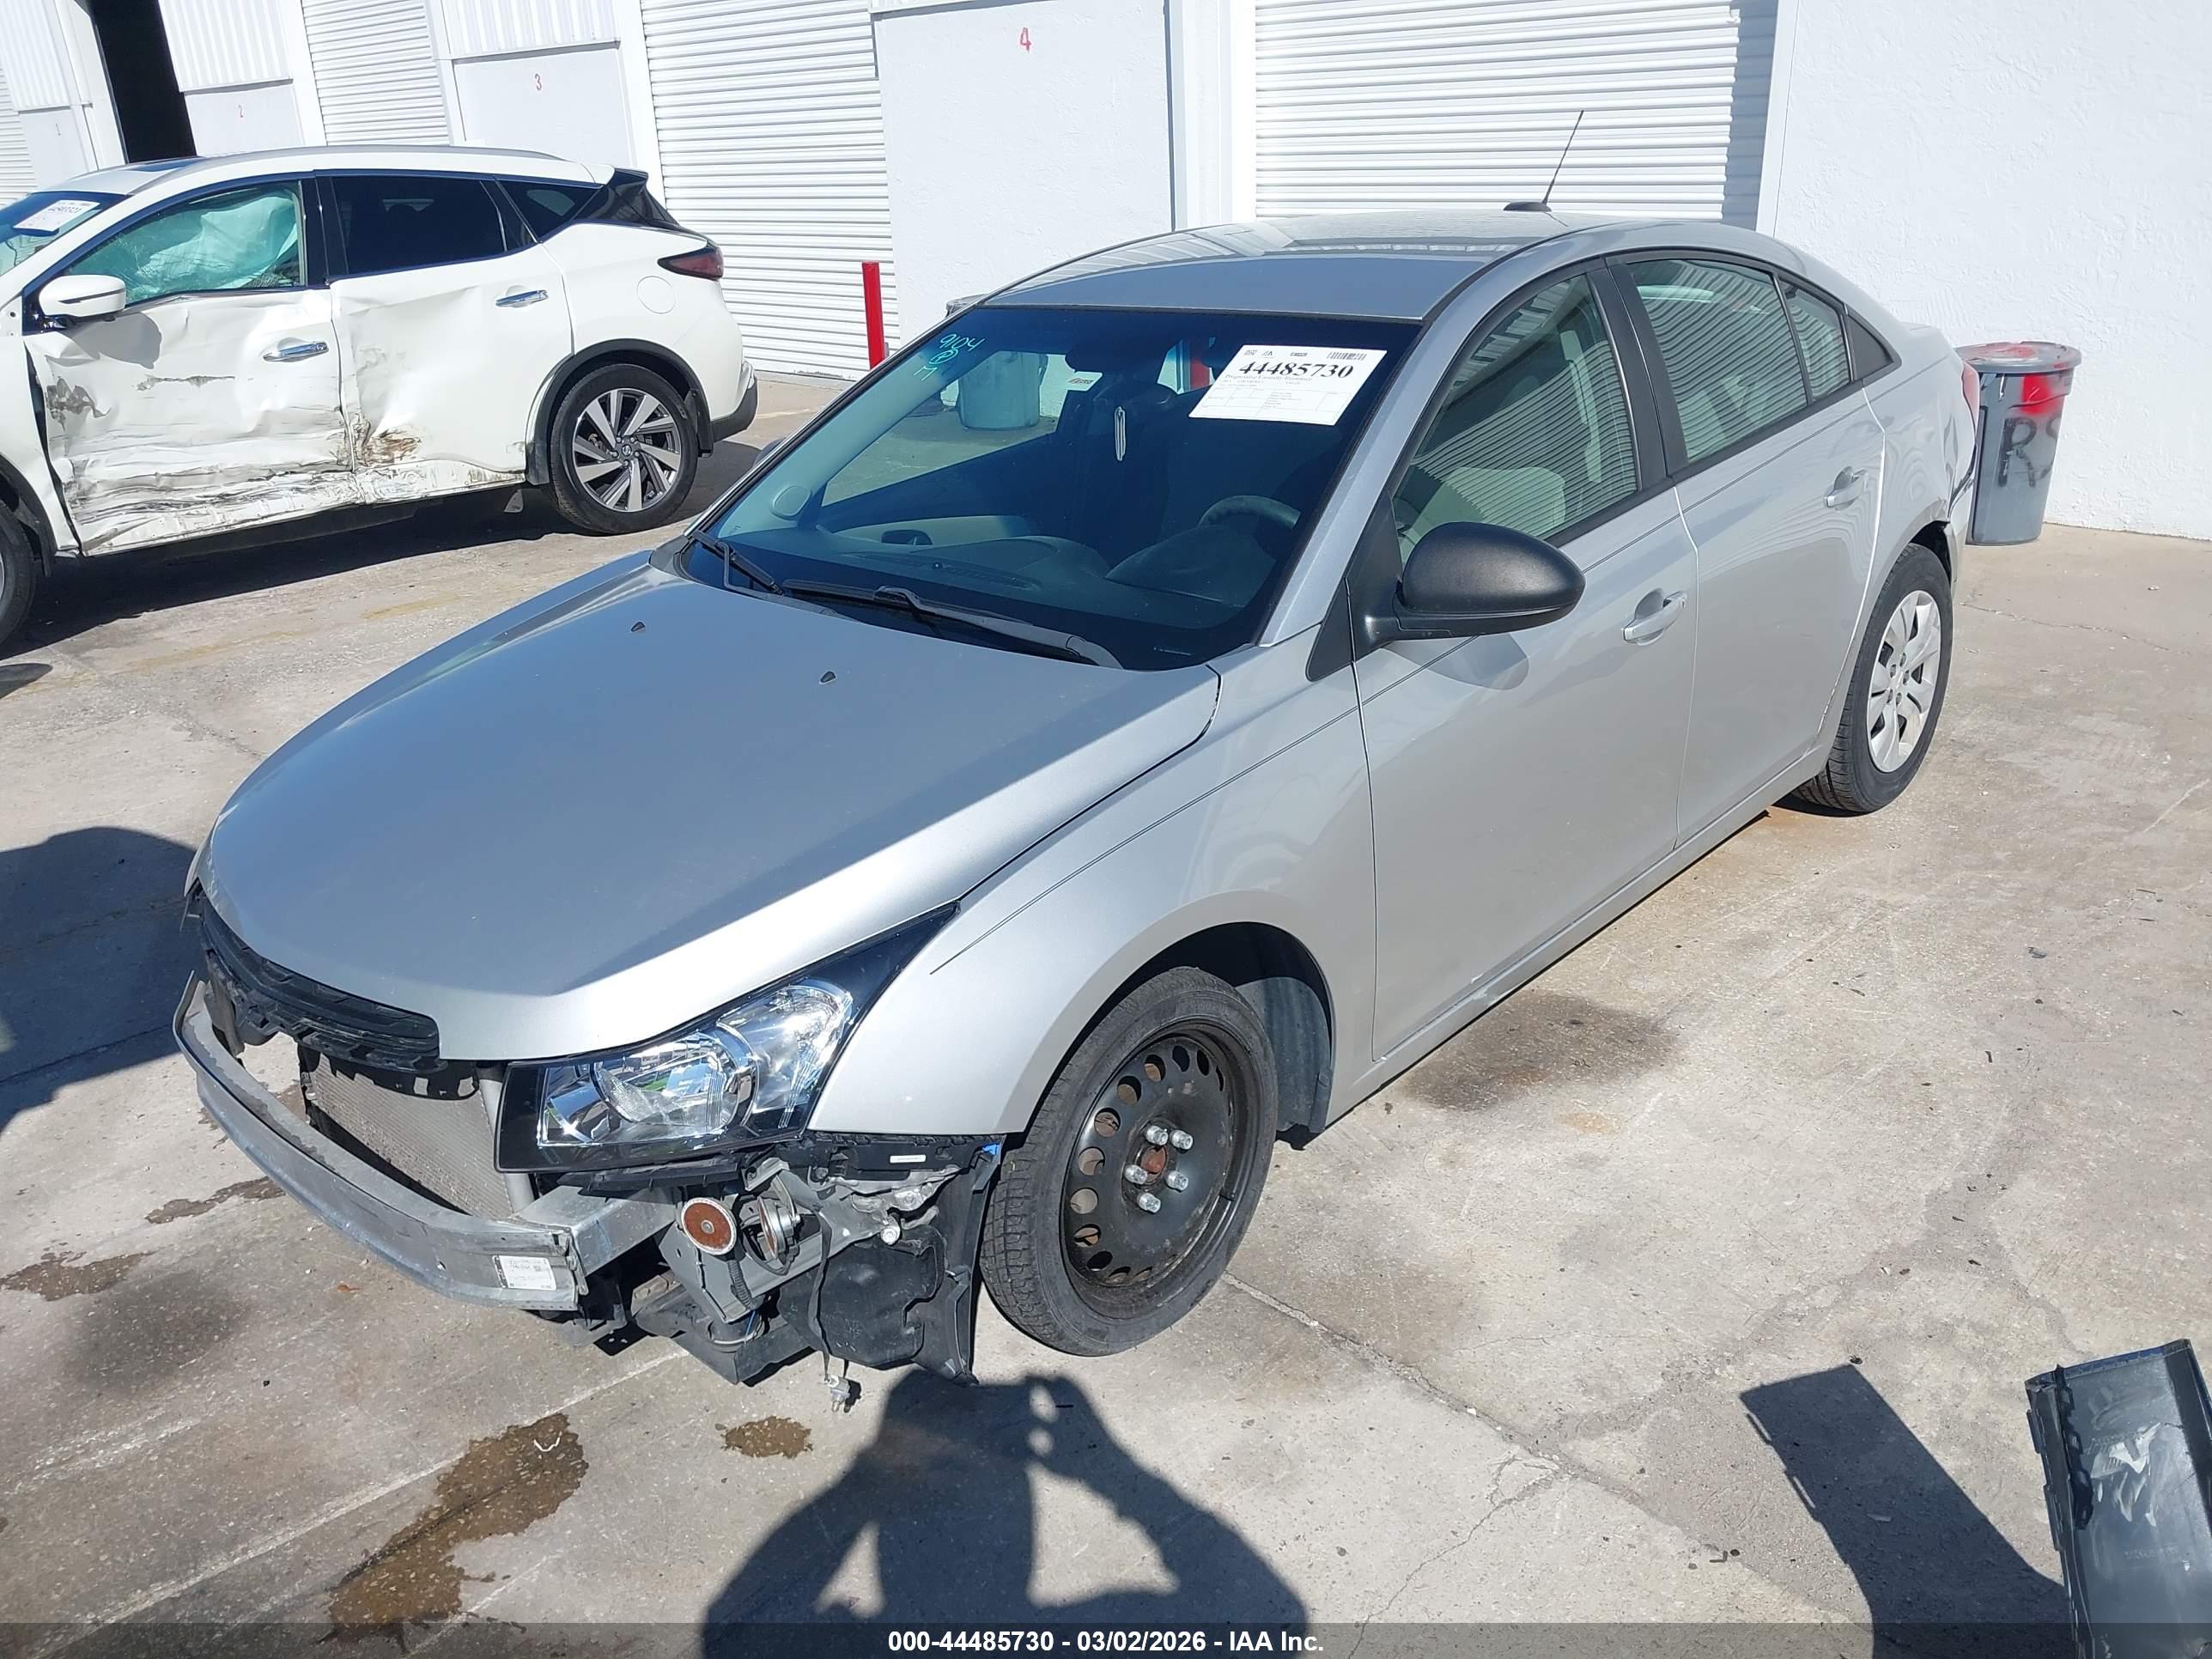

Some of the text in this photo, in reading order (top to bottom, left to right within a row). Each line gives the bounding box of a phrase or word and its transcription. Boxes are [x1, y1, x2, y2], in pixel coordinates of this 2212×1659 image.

[1020, 27, 1031, 52] 4
[534, 73, 542, 91] 3
[939, 333, 986, 352] 9104
[1238, 361, 1354, 379] 44485730
